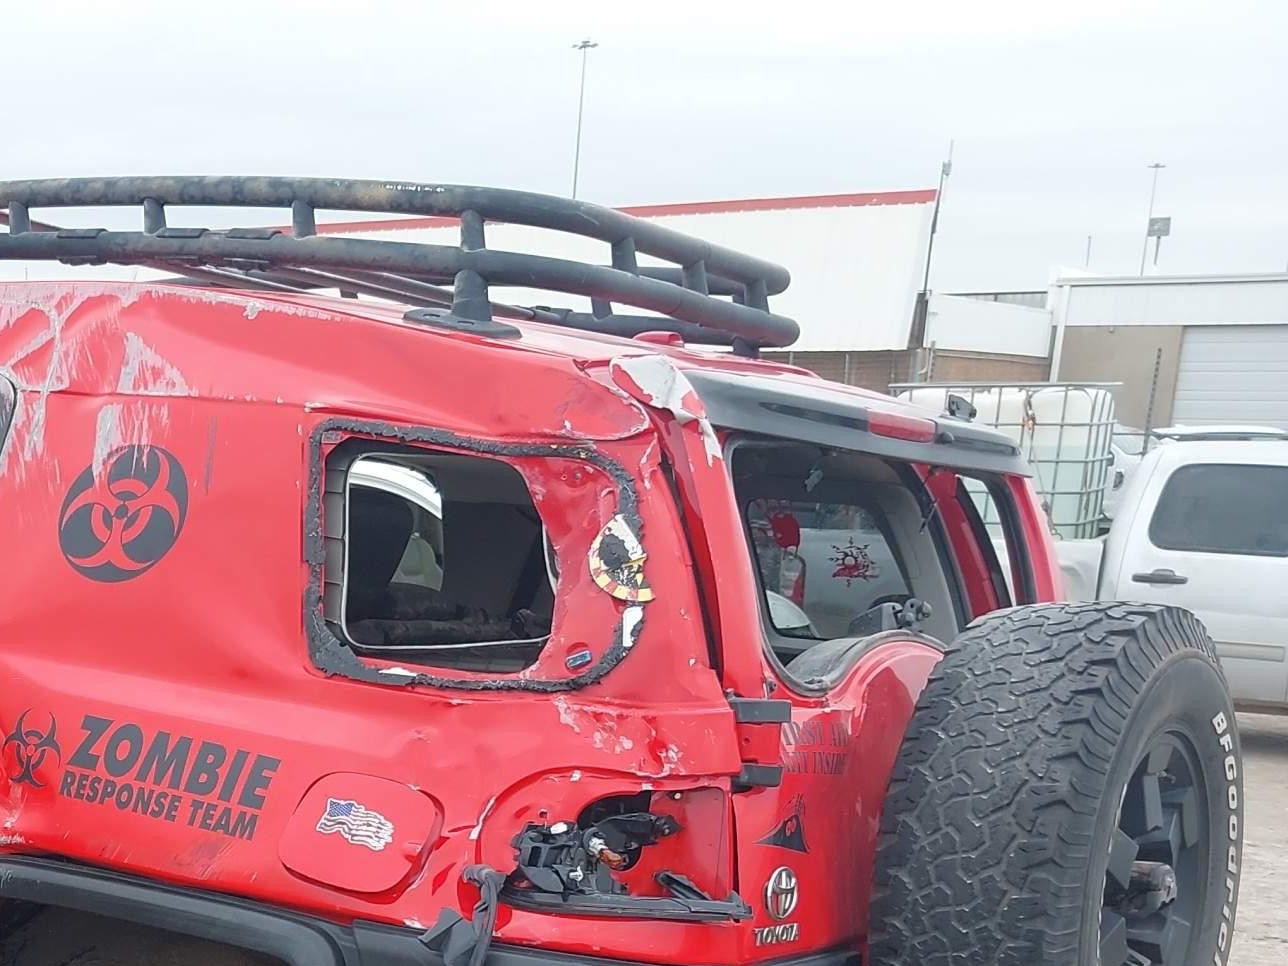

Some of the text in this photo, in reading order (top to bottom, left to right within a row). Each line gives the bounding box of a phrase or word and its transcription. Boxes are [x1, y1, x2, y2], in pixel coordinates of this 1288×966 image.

[67, 715, 282, 809] ZOMBIE
[58, 771, 260, 841] RESPONSE TEAM
[754, 923, 799, 947] TOYOTA
